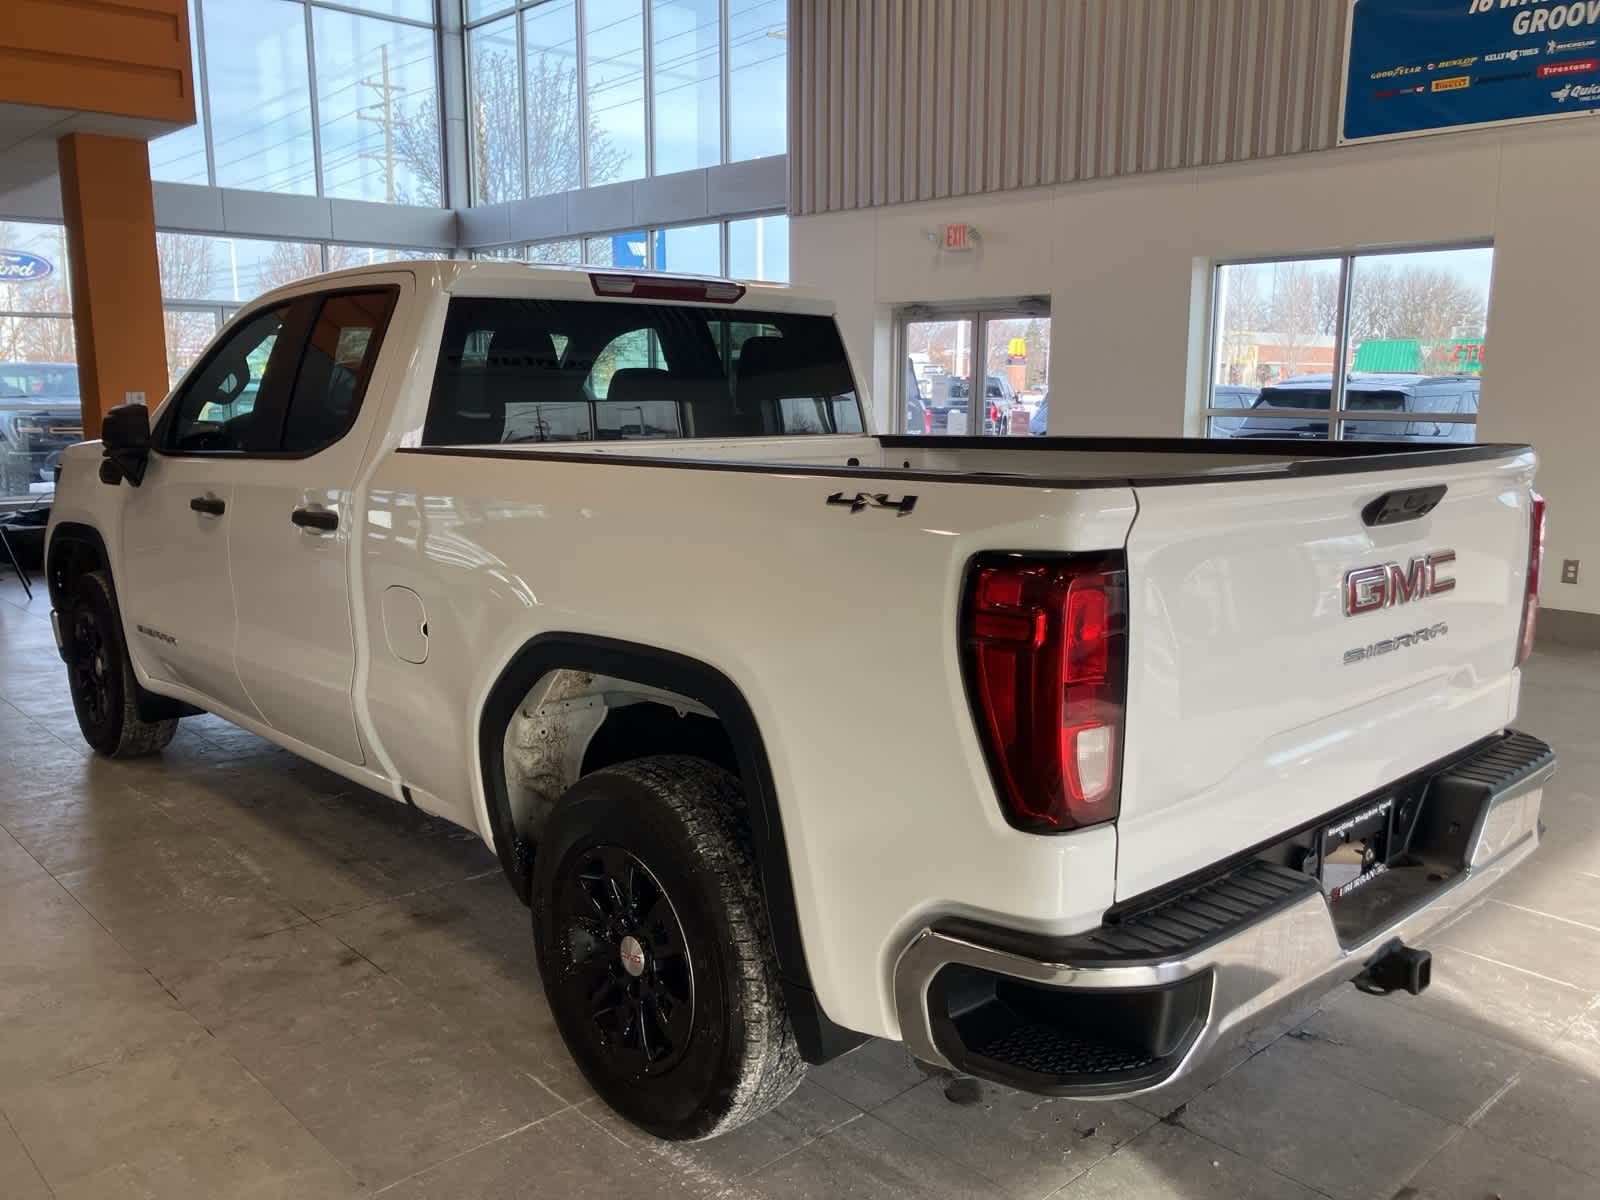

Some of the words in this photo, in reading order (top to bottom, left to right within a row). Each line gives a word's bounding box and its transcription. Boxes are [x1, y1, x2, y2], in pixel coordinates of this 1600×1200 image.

[1543, 63, 1593, 76] Firestone
[946, 223, 969, 248] EXIT
[1343, 548, 1457, 617] GMC
[1343, 621, 1449, 665] SIERRA
